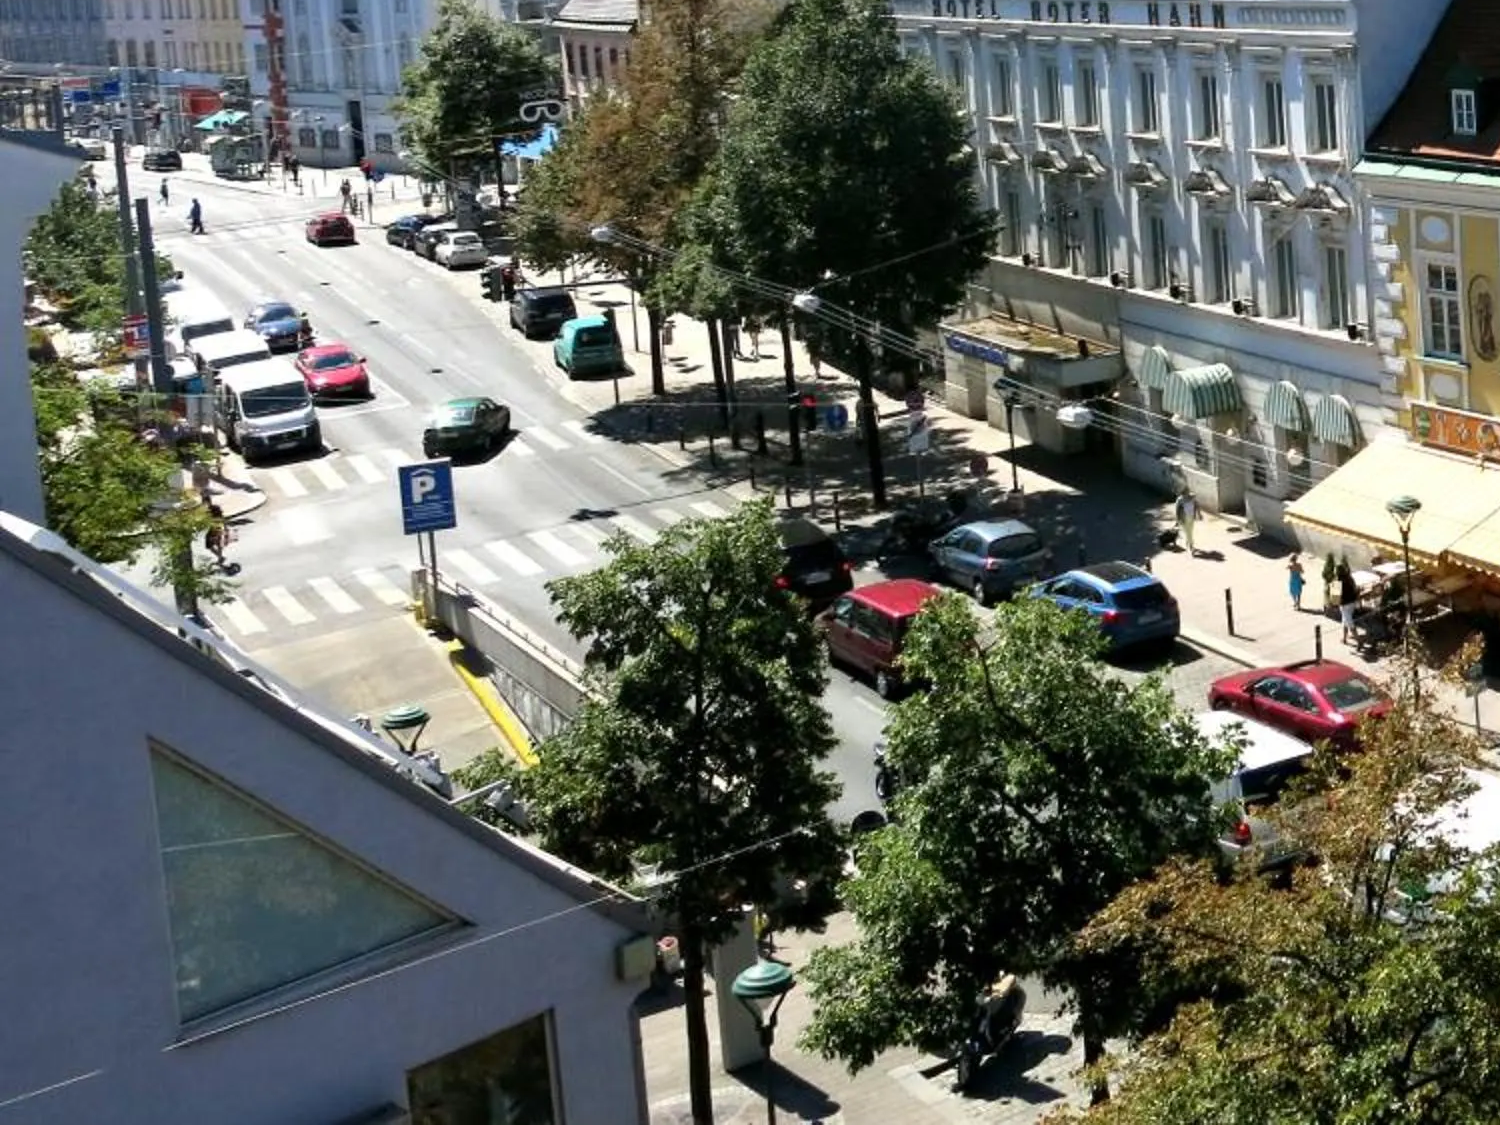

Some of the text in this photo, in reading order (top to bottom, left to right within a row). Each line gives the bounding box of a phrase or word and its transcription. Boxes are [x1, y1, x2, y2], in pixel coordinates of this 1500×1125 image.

[1030, 0, 1110, 24] ROTER
[1147, 1, 1225, 28] HAHN
[411, 475, 436, 504] P
